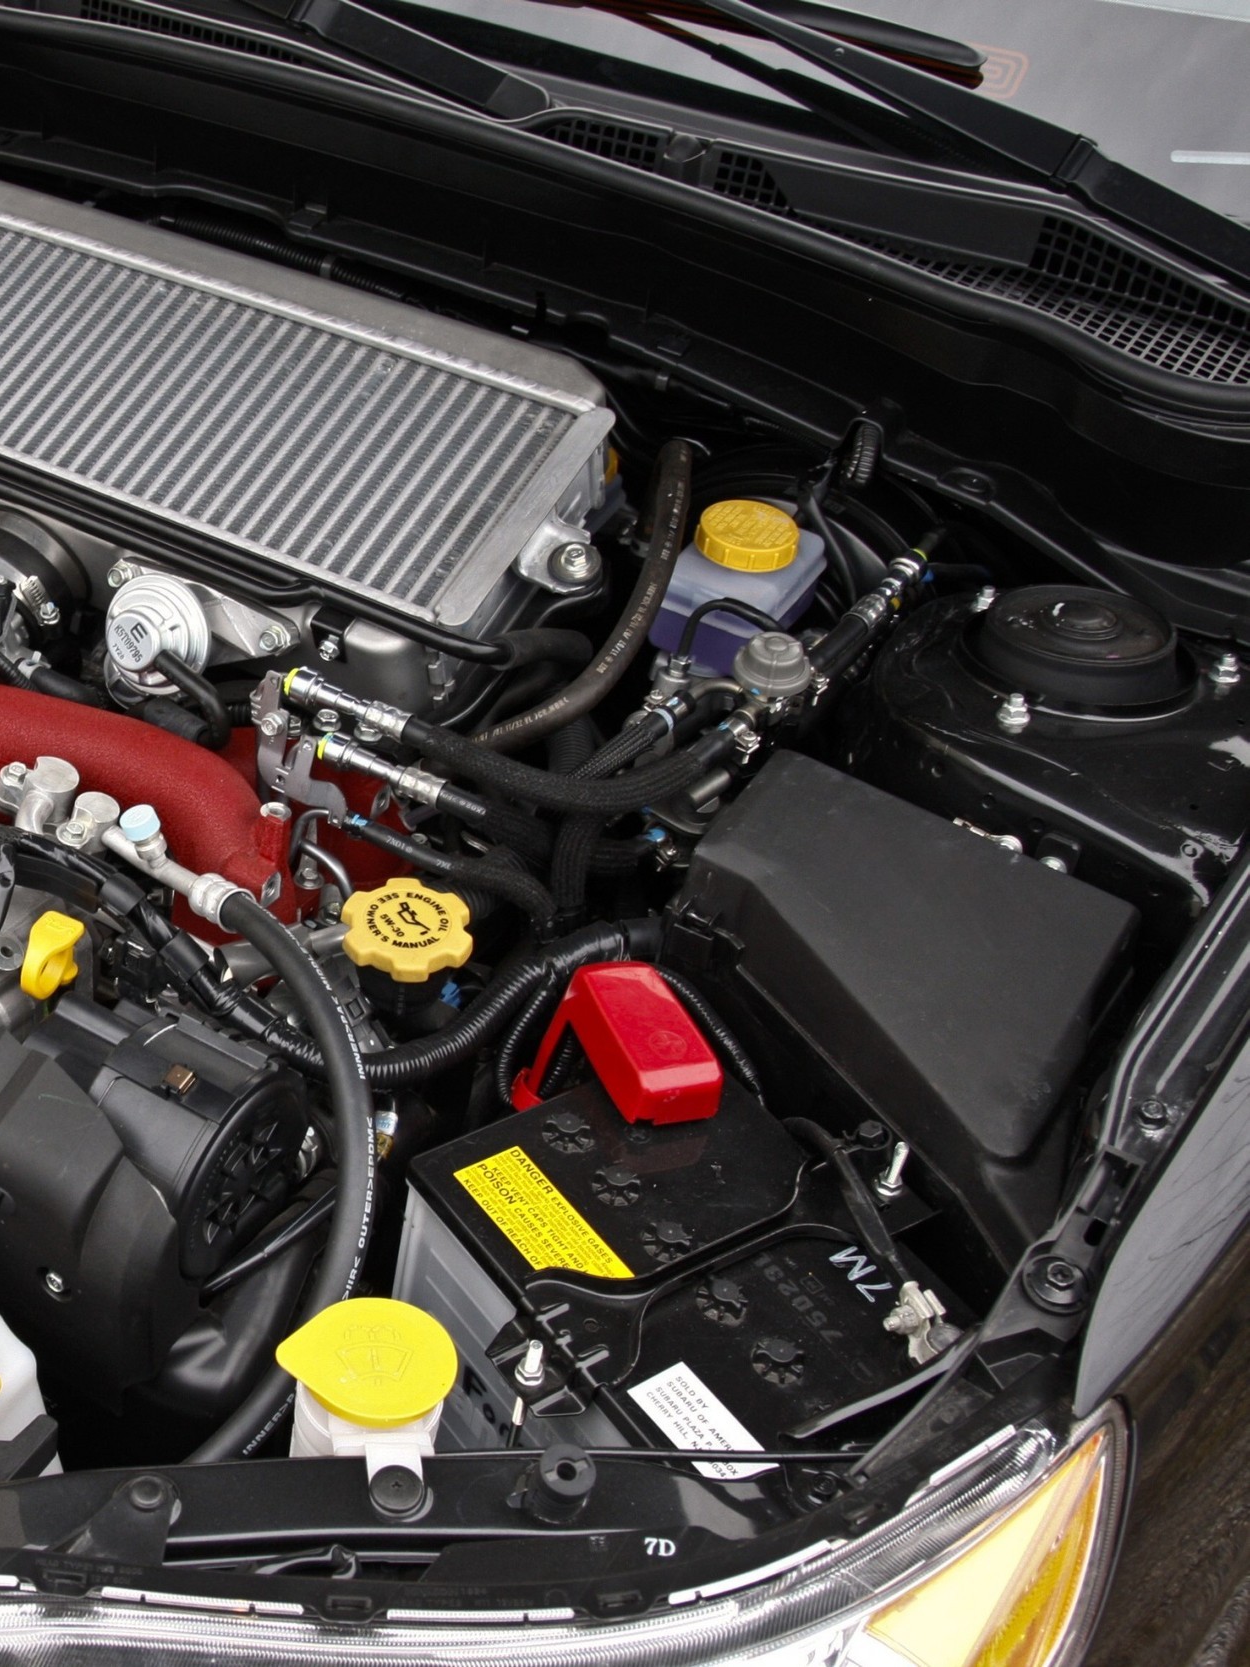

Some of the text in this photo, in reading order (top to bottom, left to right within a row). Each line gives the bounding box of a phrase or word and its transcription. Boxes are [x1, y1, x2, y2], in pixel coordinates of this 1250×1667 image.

[114, 624, 144, 663] K5T09795
[367, 892, 440, 949] SEE OWNER'S MANUAL
[380, 913, 405, 938] 5W-30
[406, 892, 449, 932] ENGINE OIL
[463, 1178, 543, 1267] KEEP OUT OF REACH OF
[477, 1163, 517, 1205] POISON
[514, 1207, 544, 1238] CAUSES
[491, 1167, 584, 1269] KEEP VENT CAPS TIGHT AND
[510, 1149, 613, 1264] DANGER EXPLOSIVE GASES
[646, 1391, 674, 1419] CHERRY
[655, 1386, 683, 1415] SUBARU
[682, 1416, 705, 1440] PLAZA
[666, 1381, 735, 1451] SUBARU OF AMER
[675, 1376, 709, 1410] SOLD BY
[644, 1537, 676, 1557] 7D
